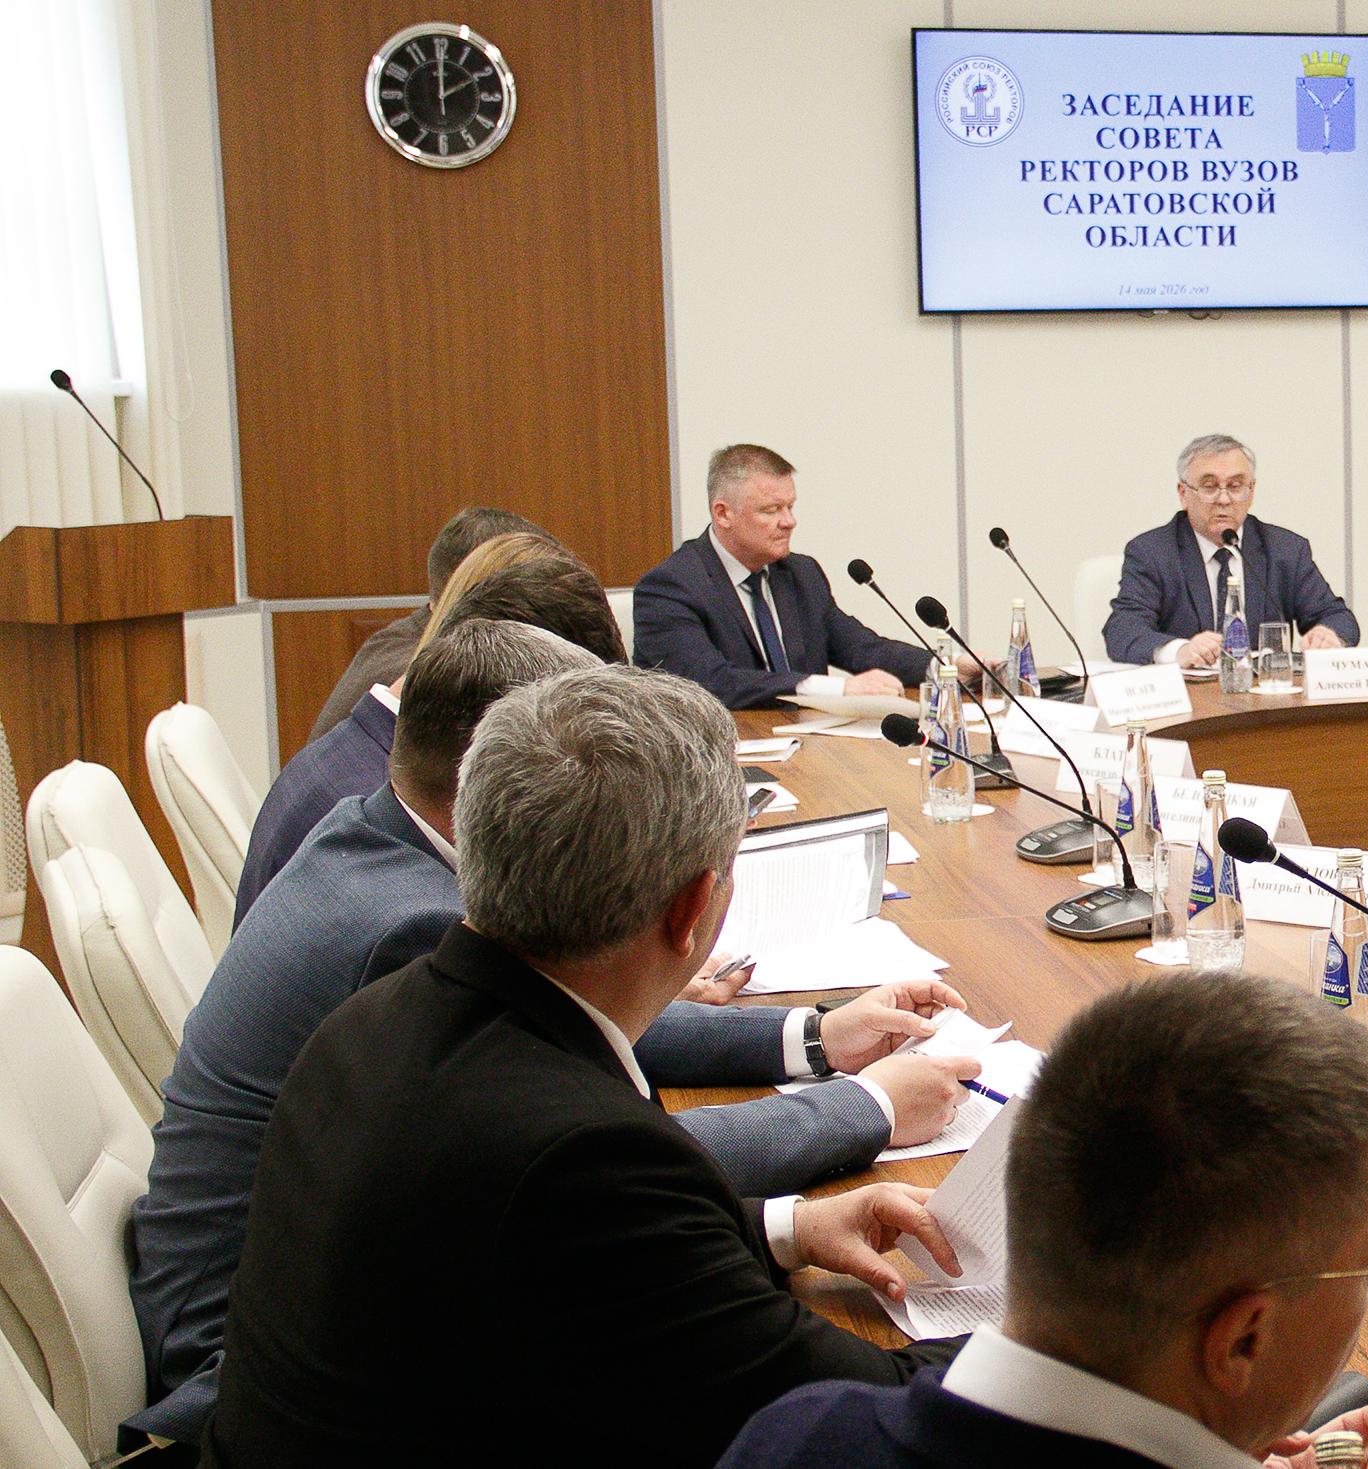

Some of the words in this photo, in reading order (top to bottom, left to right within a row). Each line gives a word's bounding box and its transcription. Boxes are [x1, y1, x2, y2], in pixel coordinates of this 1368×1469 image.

[941, 63, 969, 124] РОССИЙСКИЙ
[972, 62, 1001, 75] СОЮЗ
[1000, 73, 1018, 126] РЕКТОРОВ
[1061, 93, 1256, 120] ЗАСЕДАНИЕ
[965, 125, 998, 137] РСР
[1096, 127, 1223, 150] СОВЕТА
[1019, 159, 1190, 183] РЕКТОРОВ
[1201, 159, 1299, 183] ВУЗОВ
[1042, 187, 1277, 216] САРАТОВСКОЙ
[1085, 225, 1238, 248] ОБЛАСТИ
[1118, 285, 1132, 297] 14
[1136, 287, 1157, 296] мая
[1159, 284, 1187, 296] 2026
[1315, 678, 1362, 691] Алексей
[1246, 878, 1302, 894] Дмитрий
